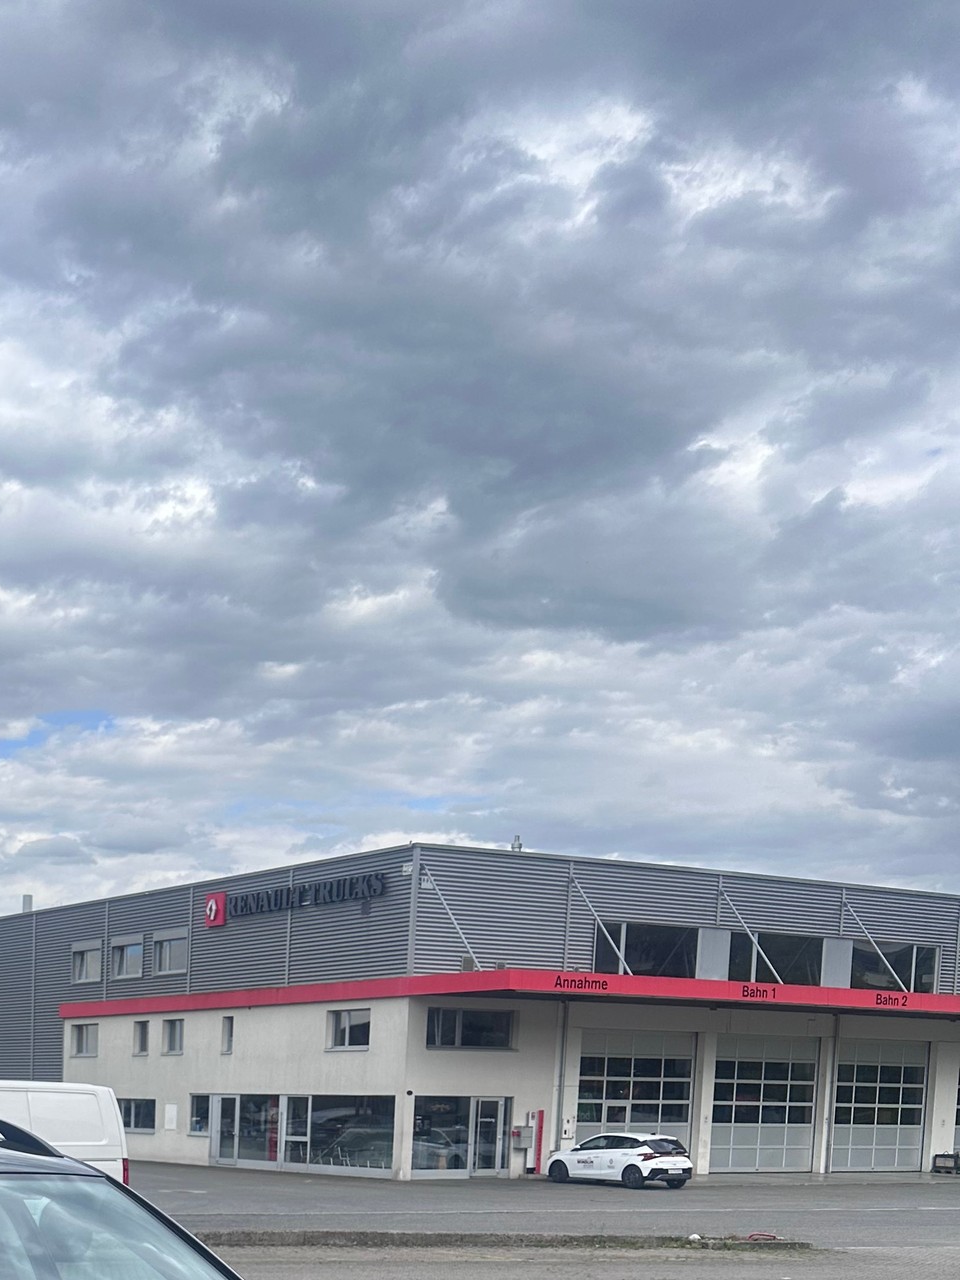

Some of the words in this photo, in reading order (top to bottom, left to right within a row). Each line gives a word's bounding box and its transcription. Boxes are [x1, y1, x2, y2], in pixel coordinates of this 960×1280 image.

[227, 886, 303, 917] RENAULT
[308, 873, 385, 905] TRUCKS
[554, 976, 609, 991] Annahme
[742, 985, 768, 999] Bahn
[771, 987, 776, 999] 1
[875, 993, 899, 1006] Bahn
[901, 995, 908, 1007] 2
